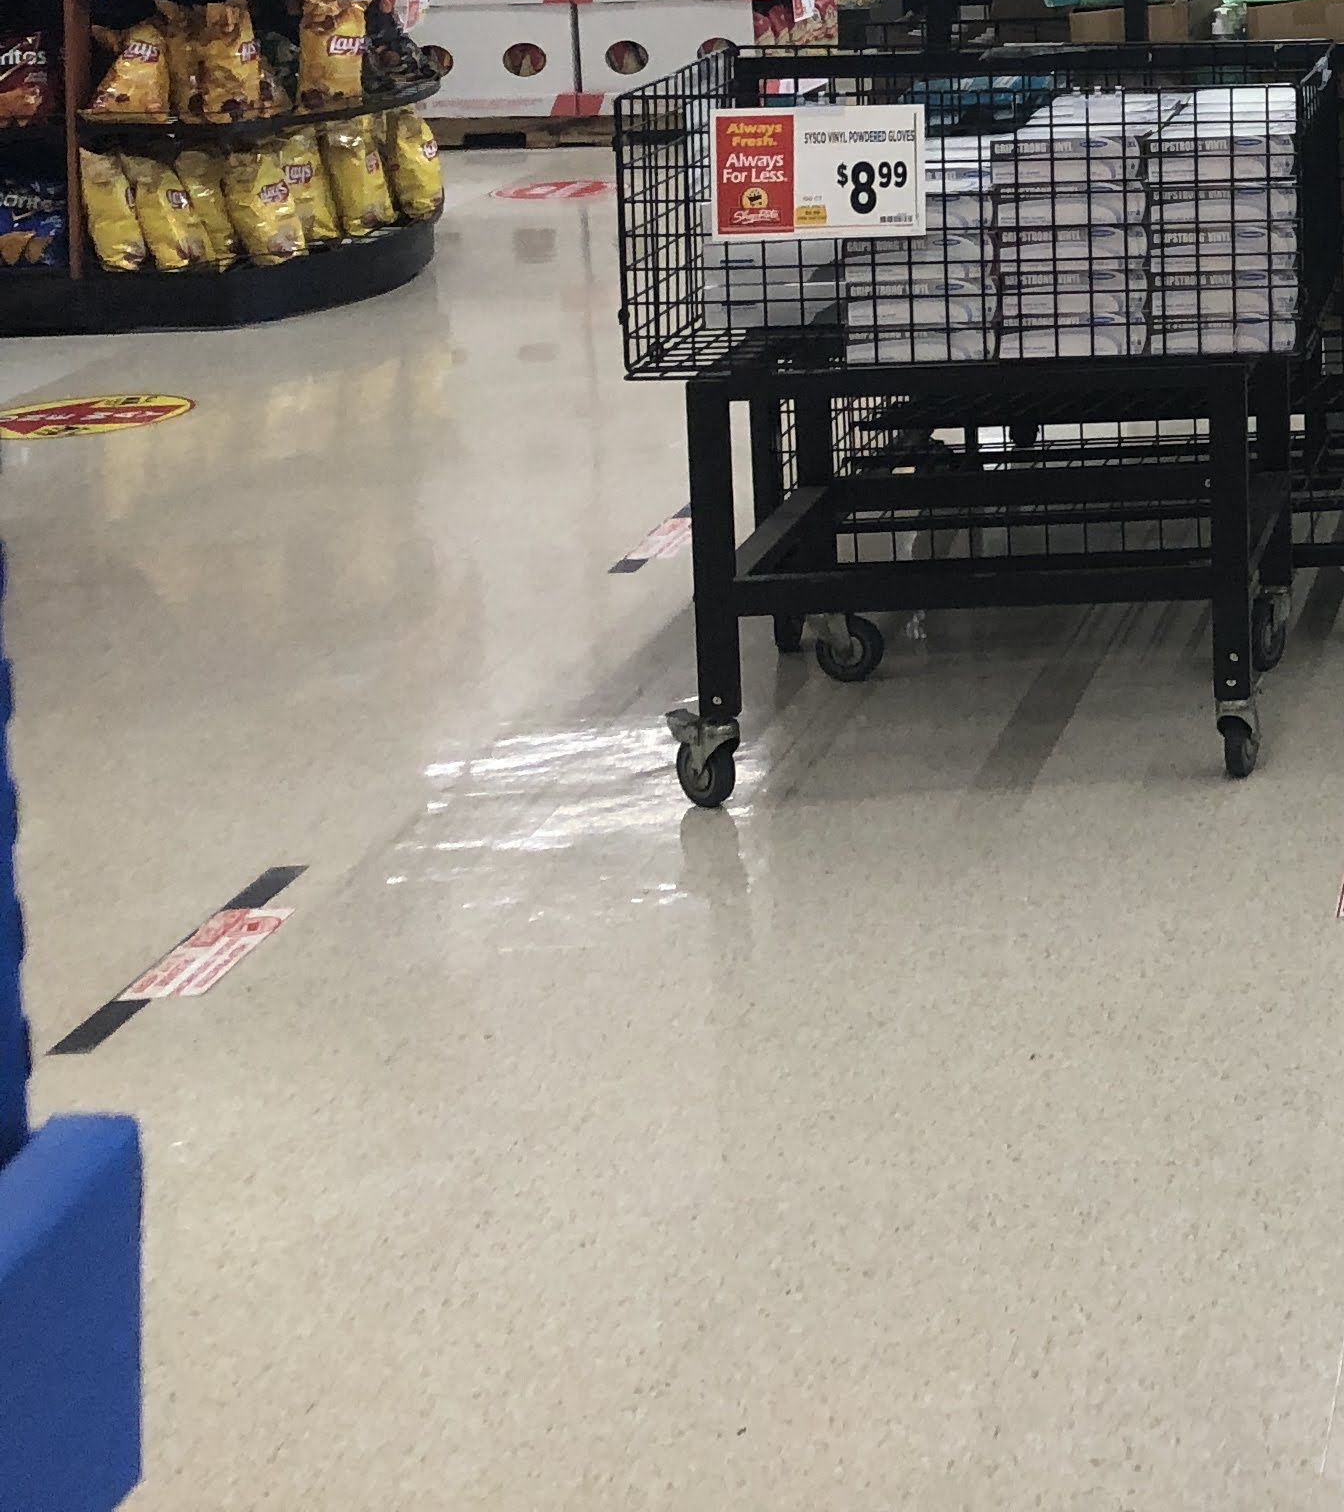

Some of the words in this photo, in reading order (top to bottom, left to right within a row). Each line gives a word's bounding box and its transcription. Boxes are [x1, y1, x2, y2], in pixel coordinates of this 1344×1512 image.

[727, 122, 783, 137] Always
[803, 132, 827, 145] SYSCO
[827, 131, 849, 144] VINYL
[848, 130, 887, 144] POWDERED
[887, 129, 916, 143] GLOVES
[725, 153, 785, 168] Always
[722, 169, 748, 184] For
[751, 169, 788, 184] Less.
